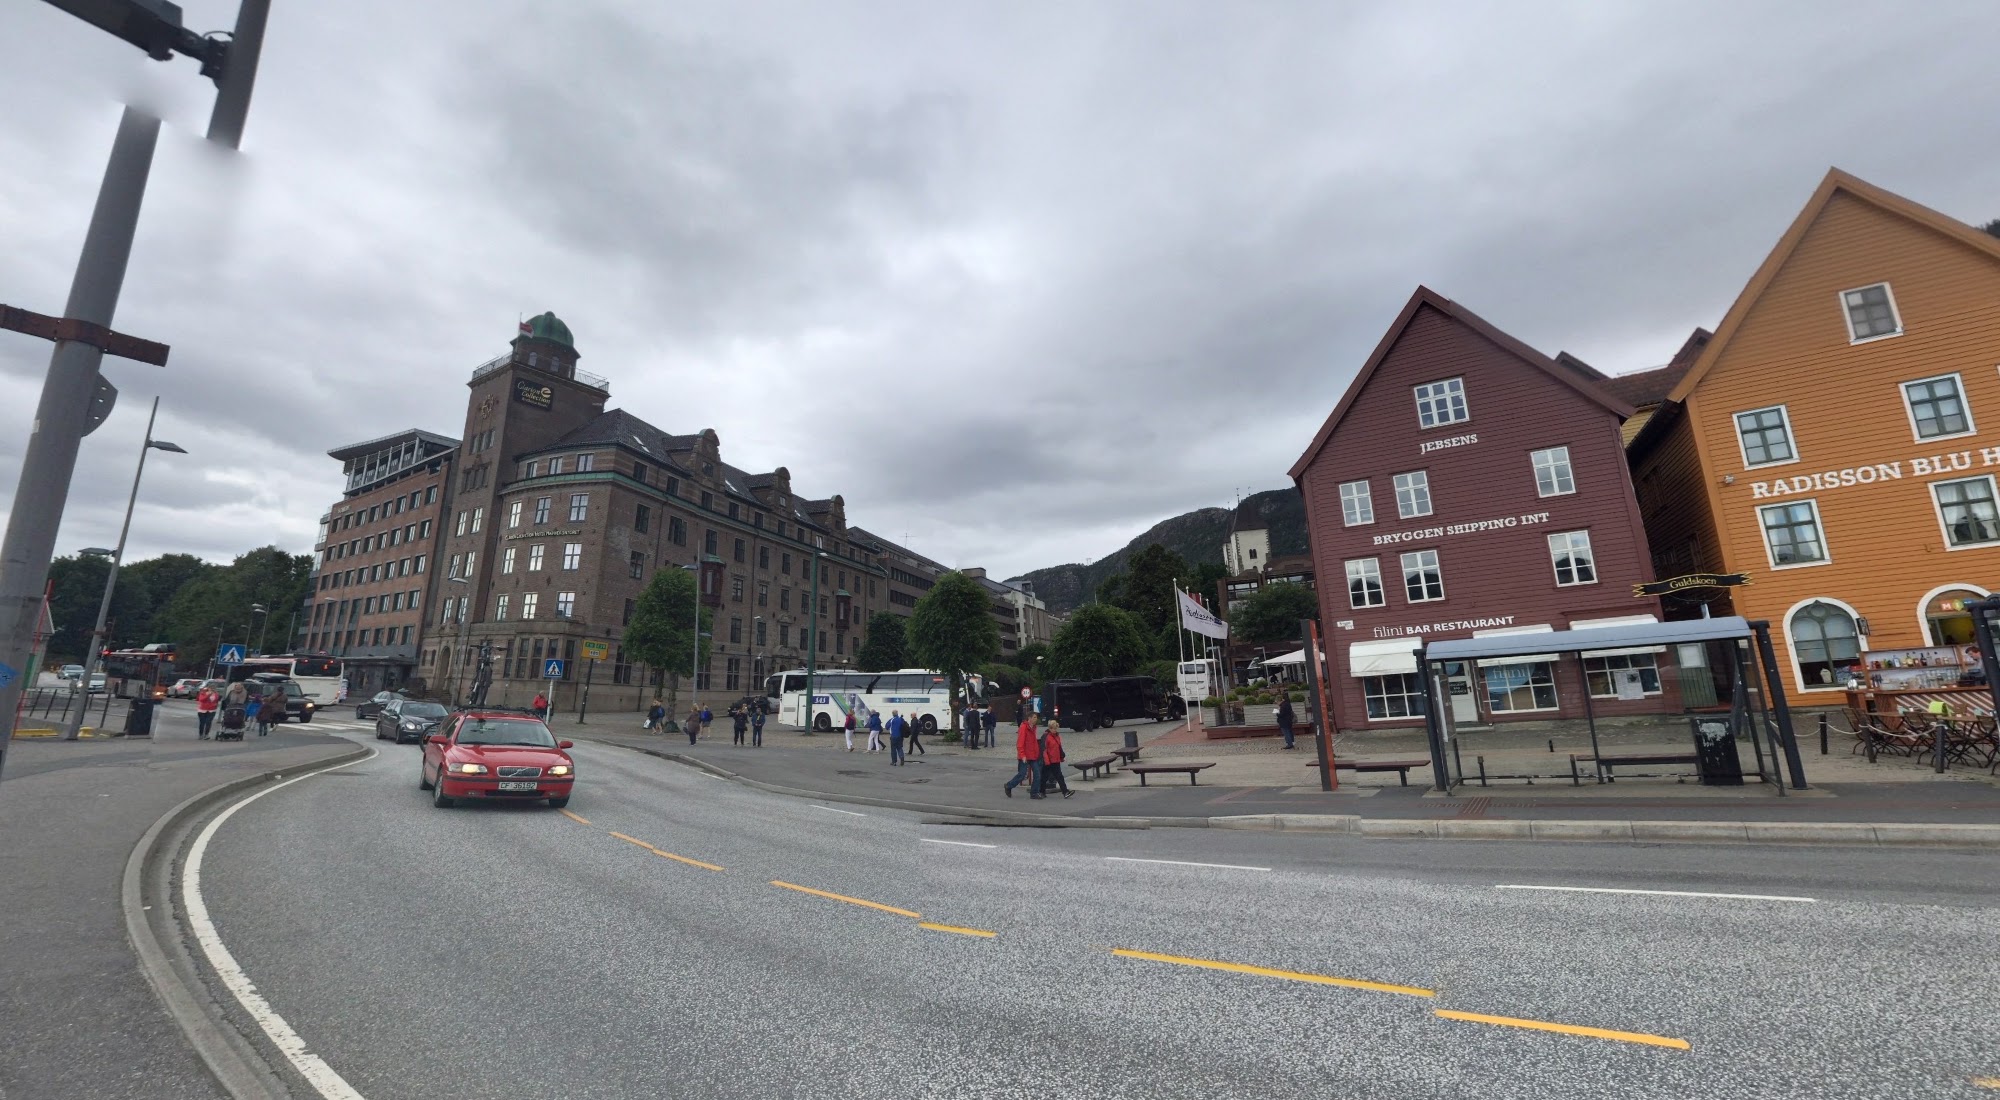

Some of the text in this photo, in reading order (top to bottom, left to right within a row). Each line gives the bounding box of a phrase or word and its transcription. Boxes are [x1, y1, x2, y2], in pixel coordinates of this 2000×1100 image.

[521, 390, 551, 405] Collection
[1419, 433, 1478, 455] JEBSENS
[1749, 461, 1902, 499] RADISSON
[1908, 450, 1972, 477] BLU
[1373, 512, 1550, 545] BRYGGEN SHIPPING INT
[1669, 576, 1717, 589] Guldskoen
[1373, 615, 1515, 638] filini BAR RESTAURANT
